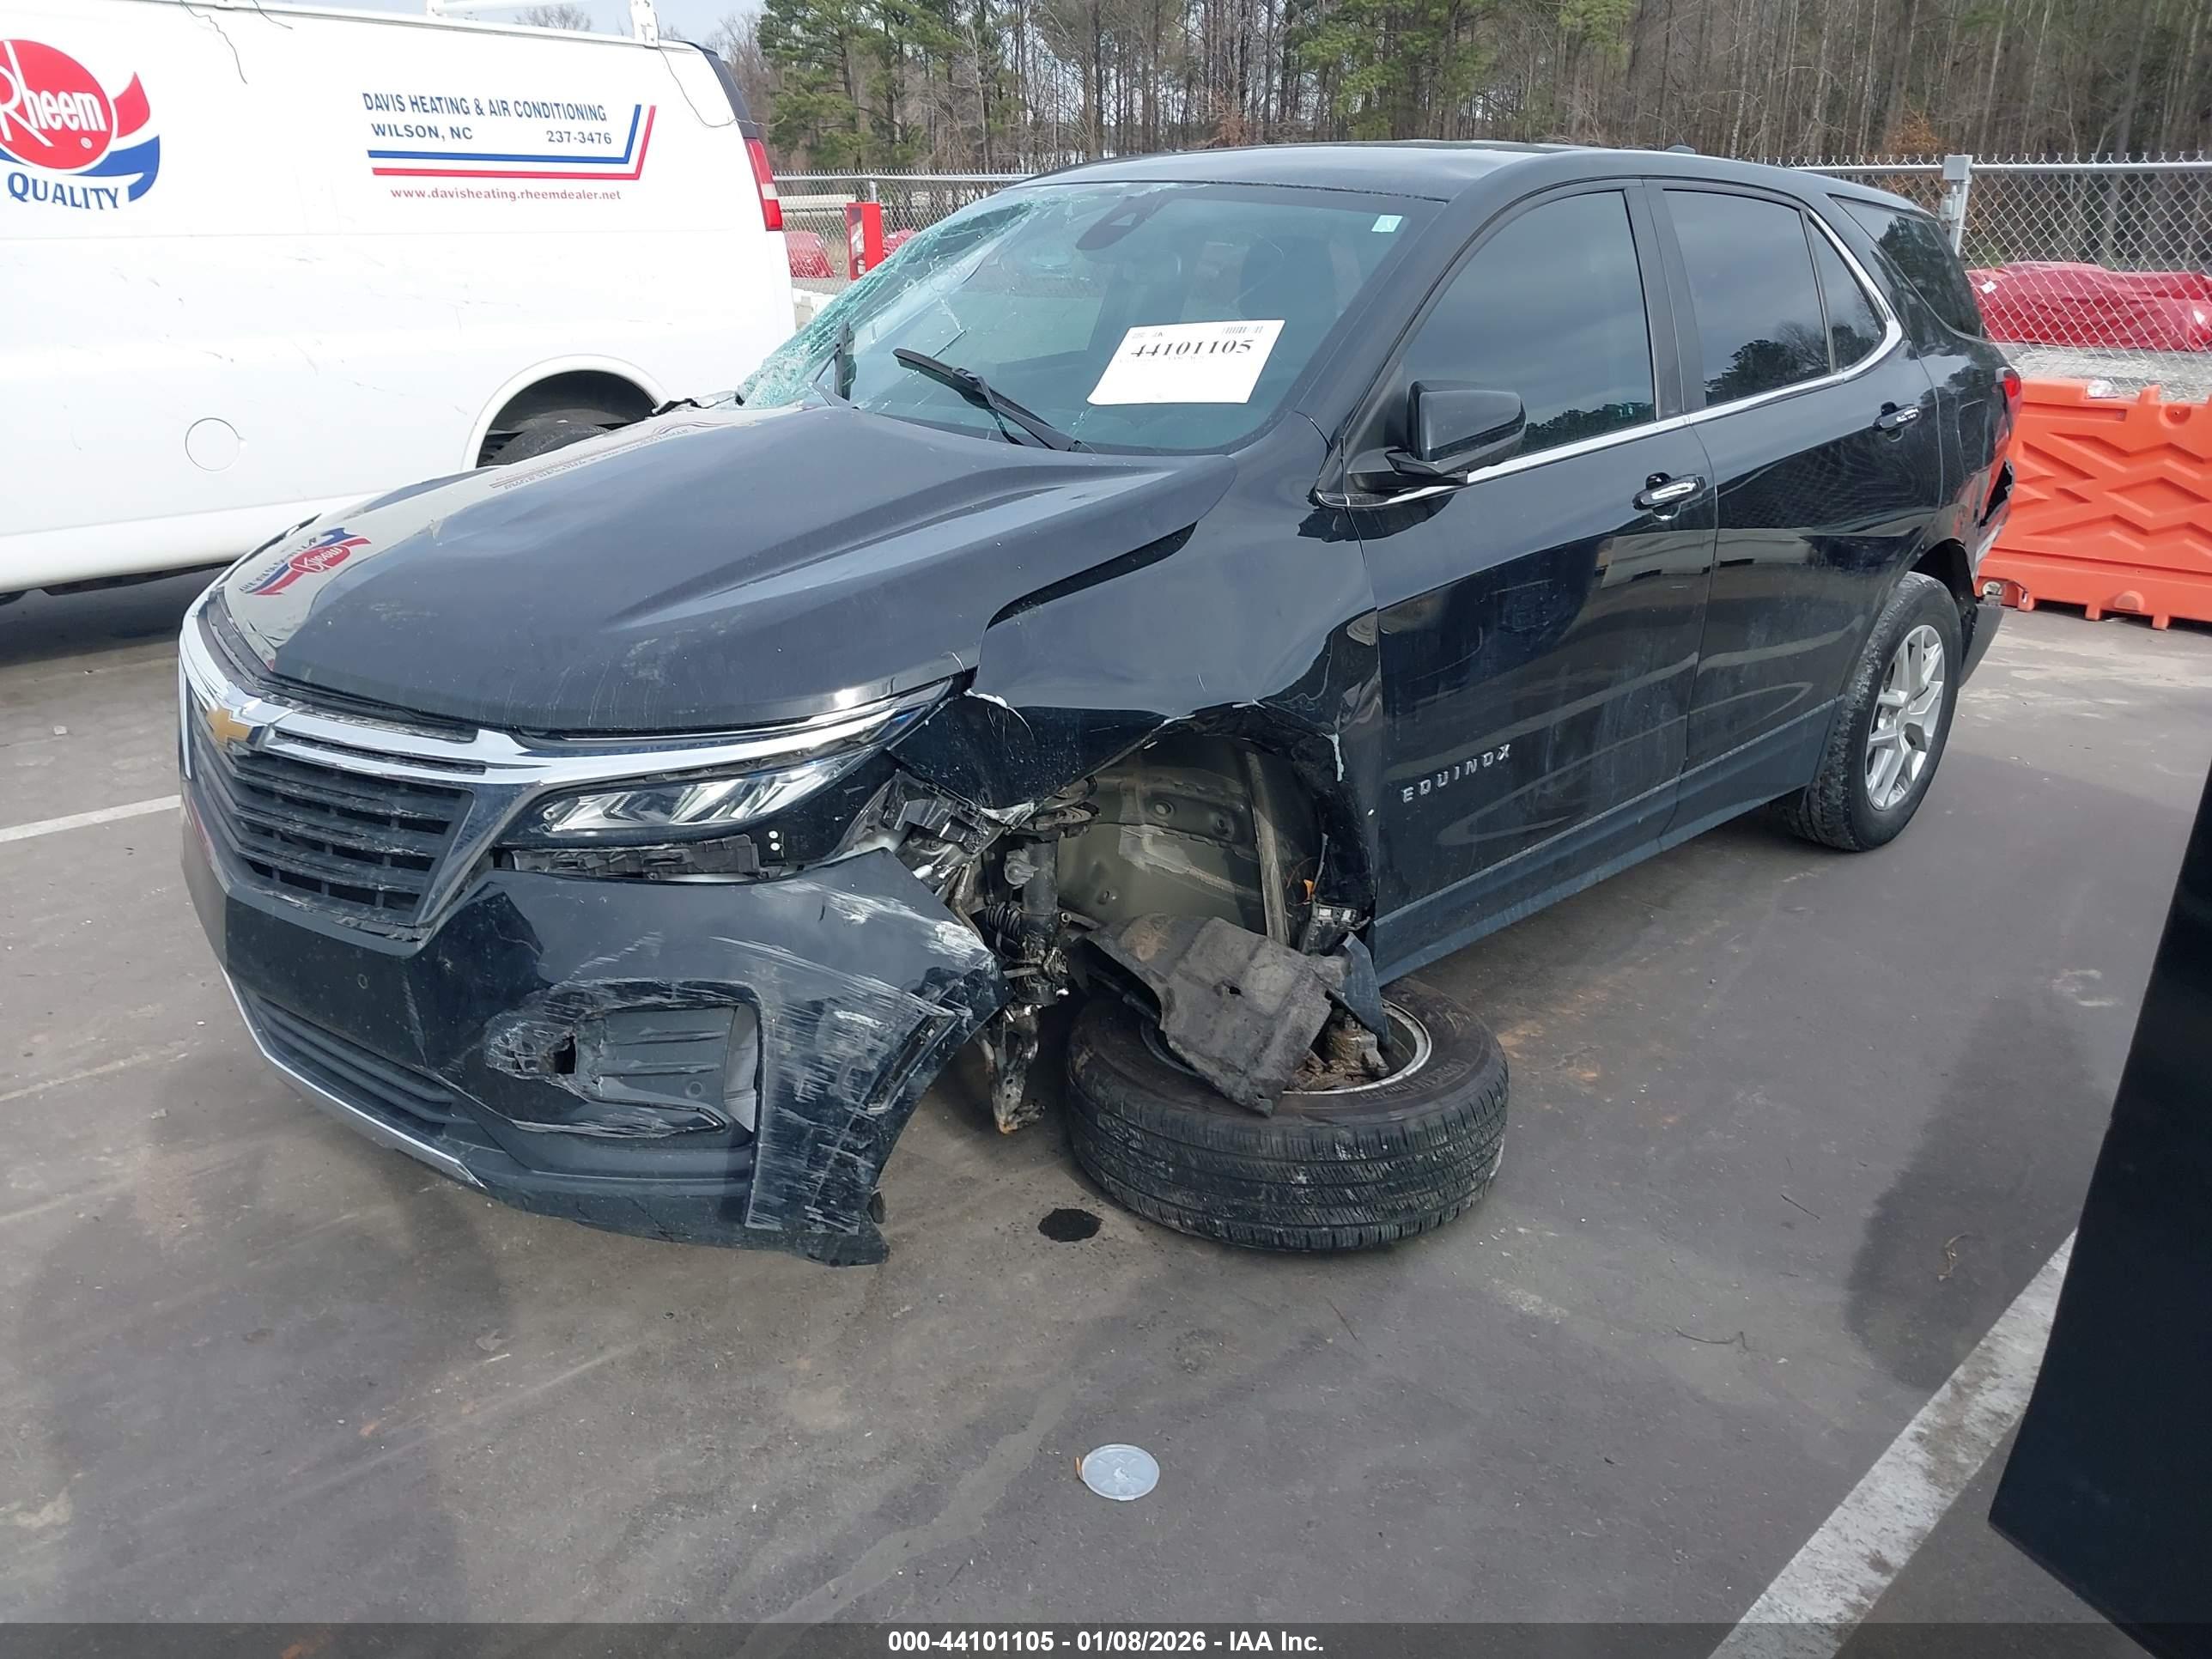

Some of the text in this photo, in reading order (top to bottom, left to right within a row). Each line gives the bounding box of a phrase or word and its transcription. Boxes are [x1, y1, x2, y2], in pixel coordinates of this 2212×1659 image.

[0, 40, 107, 147] Rheem
[362, 93, 607, 122] DAVIS HEATING & AIR CONDITIONING
[371, 123, 612, 144] WILSON, NC 237-3476
[8, 172, 118, 210] QUALITY
[391, 187, 622, 202] www.davisheating.rheemdealer.net
[1131, 339, 1255, 358] 44101105
[1401, 744, 1511, 803] EQUINOX
